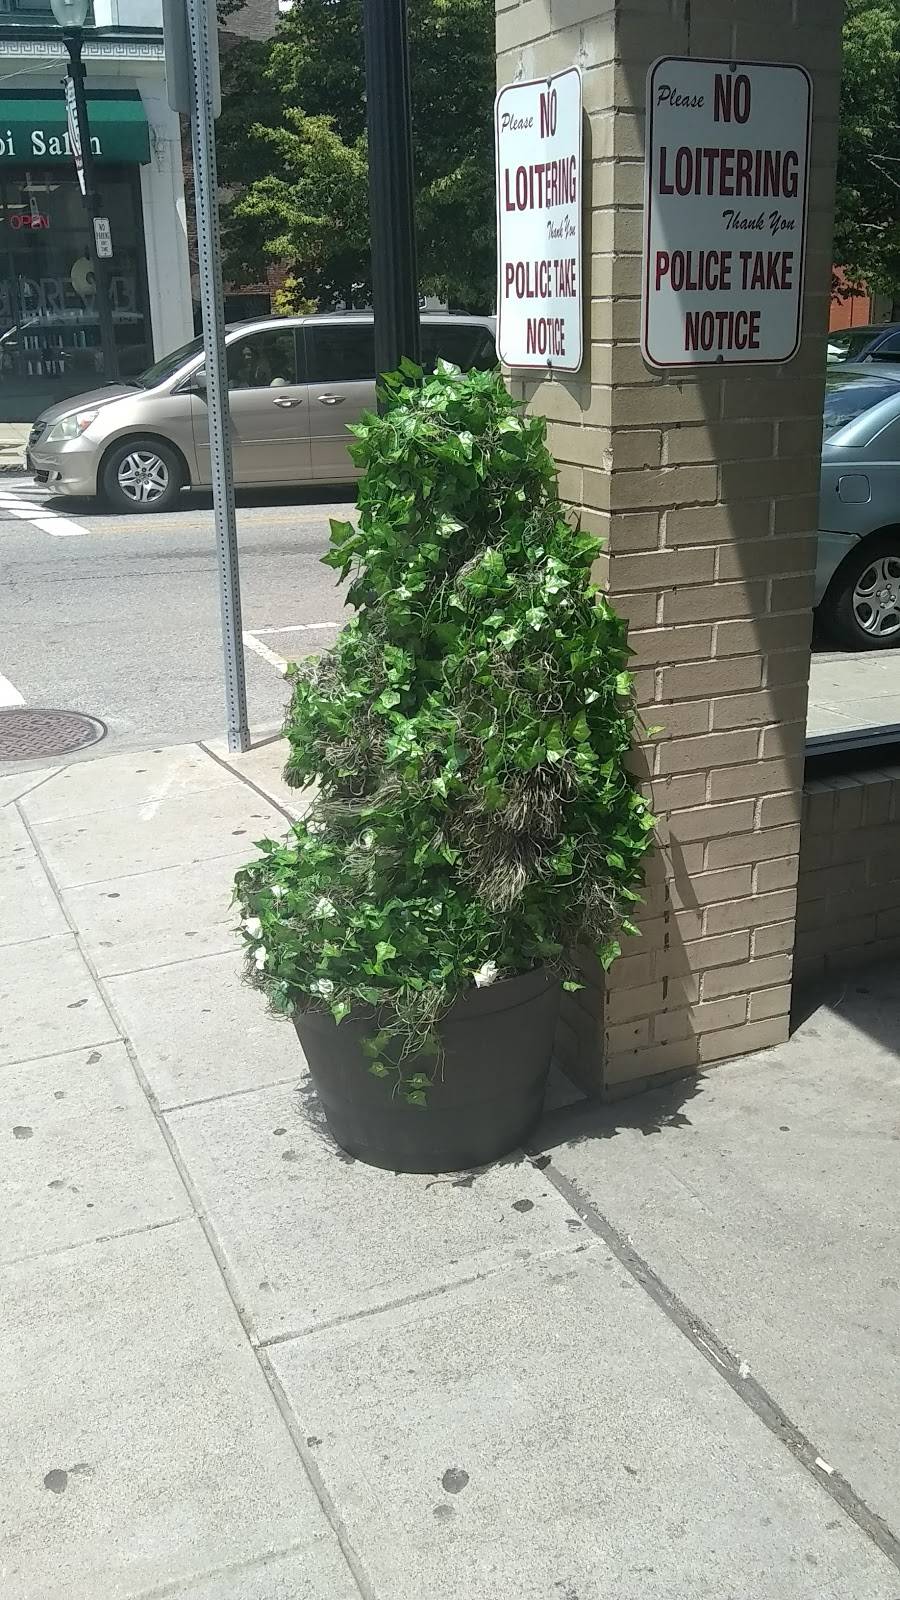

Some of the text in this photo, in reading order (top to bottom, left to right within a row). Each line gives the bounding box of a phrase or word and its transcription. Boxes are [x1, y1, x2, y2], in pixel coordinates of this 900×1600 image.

[501, 88, 557, 139] Please NO
[657, 73, 751, 124] Please NO
[0, 130, 102, 156] i Saln
[505, 154, 577, 211] LOITERING
[659, 146, 799, 198] LOITERING
[10, 215, 50, 229] OPEN
[547, 214, 576, 240] Thank You
[722, 209, 795, 236] Thank You
[505, 258, 576, 299] POLICE TAKE
[656, 250, 794, 292] POLICE TAKE
[527, 317, 565, 356] NOTICE
[684, 310, 761, 351] NOTICE
